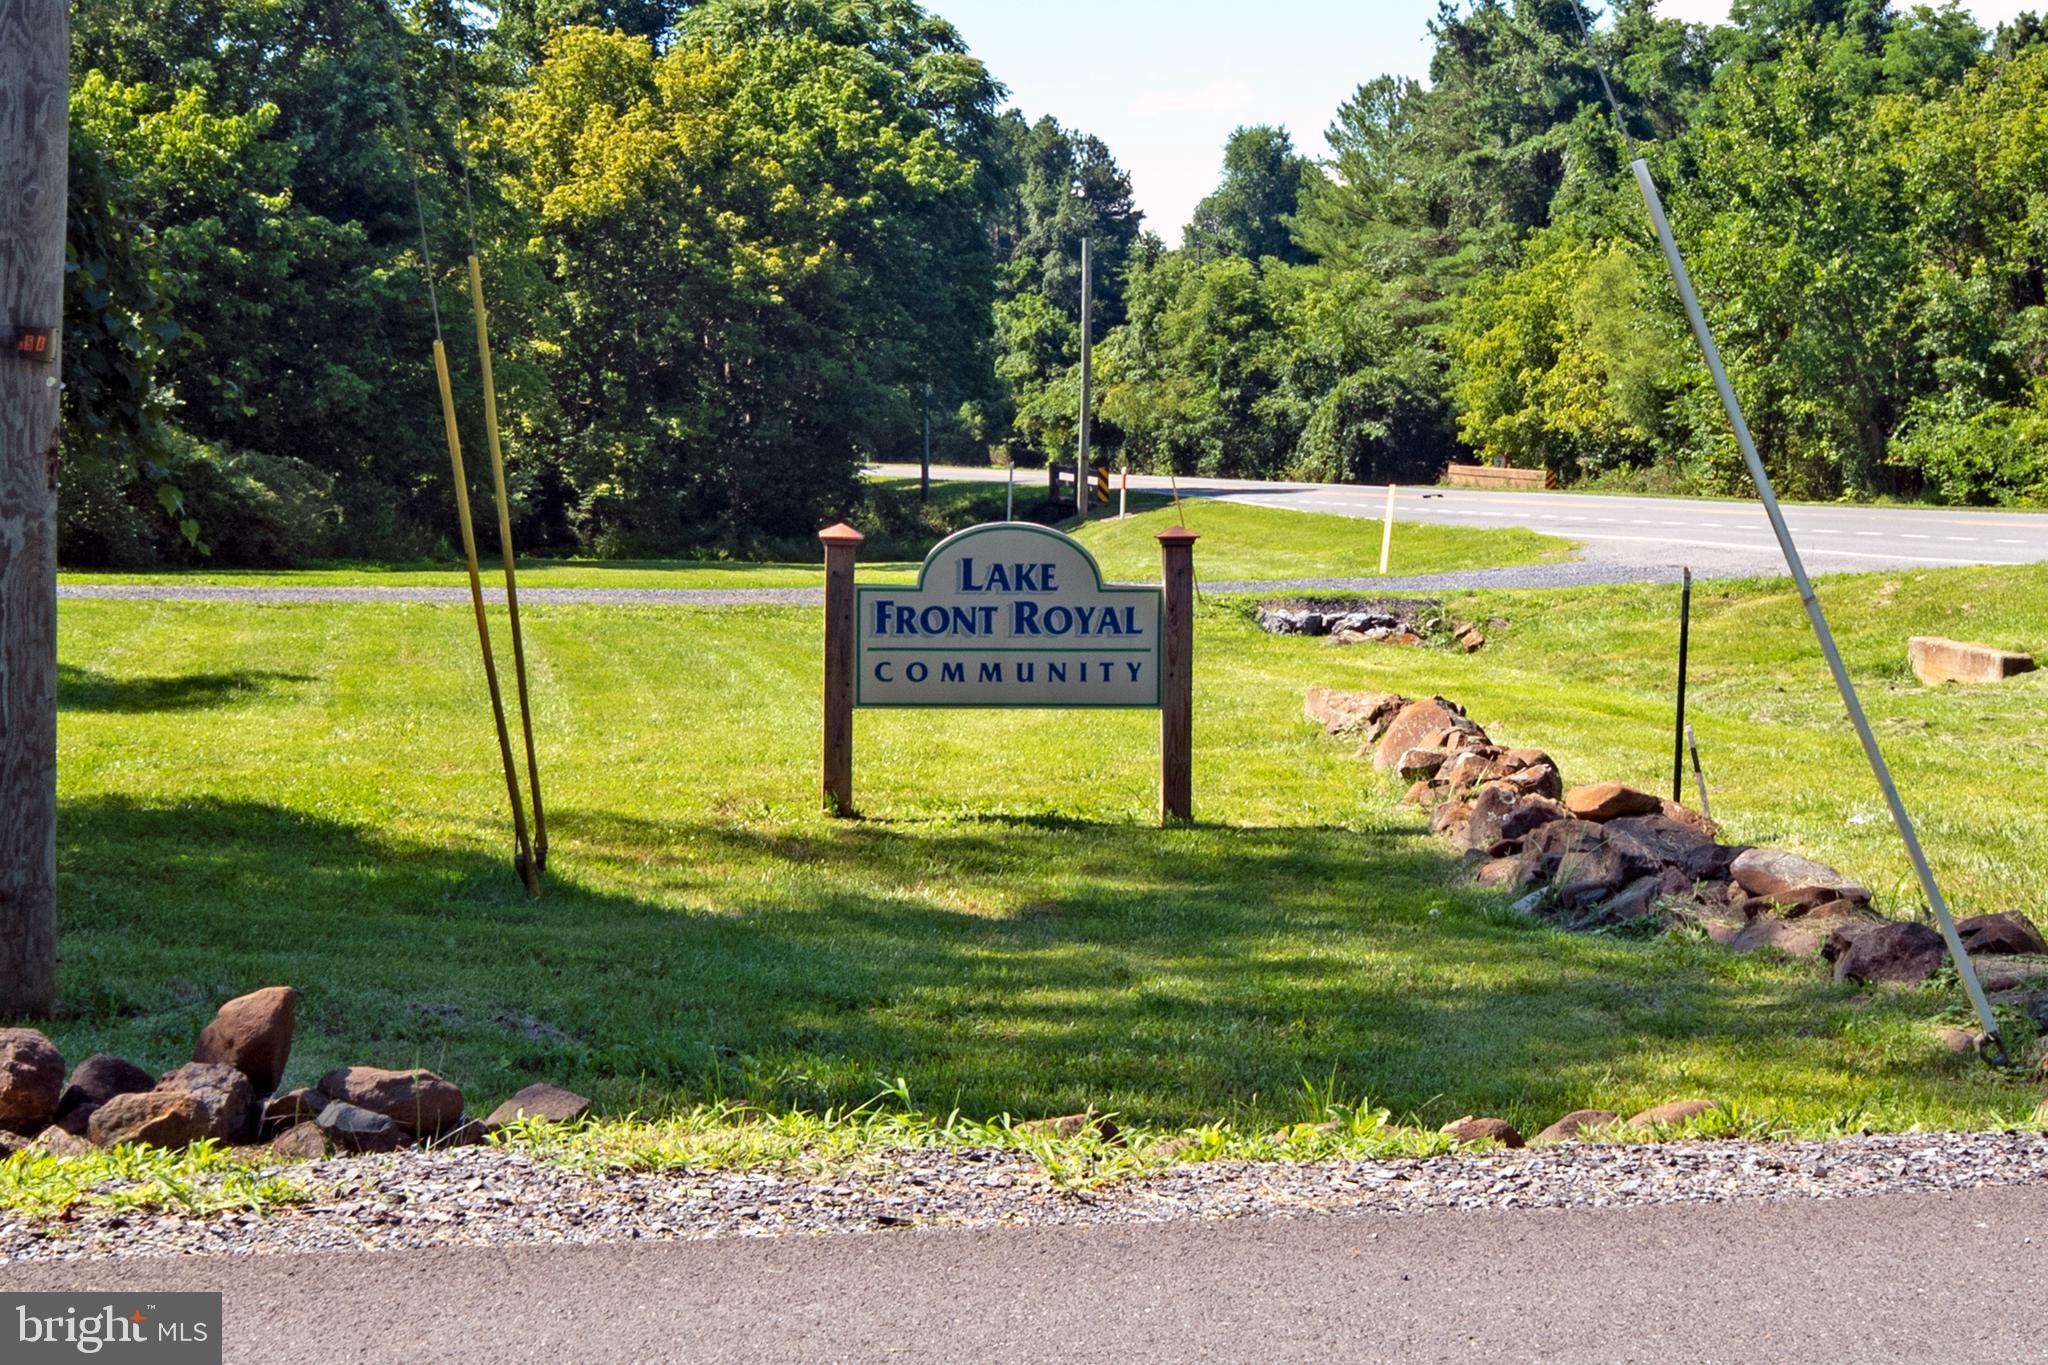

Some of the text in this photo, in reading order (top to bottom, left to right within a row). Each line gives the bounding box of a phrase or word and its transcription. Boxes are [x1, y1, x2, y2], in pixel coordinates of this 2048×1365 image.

[959, 557, 1059, 593] LAKE
[873, 599, 1144, 637] FRONT ROYAL
[873, 661, 1143, 683] COMMUNITY
